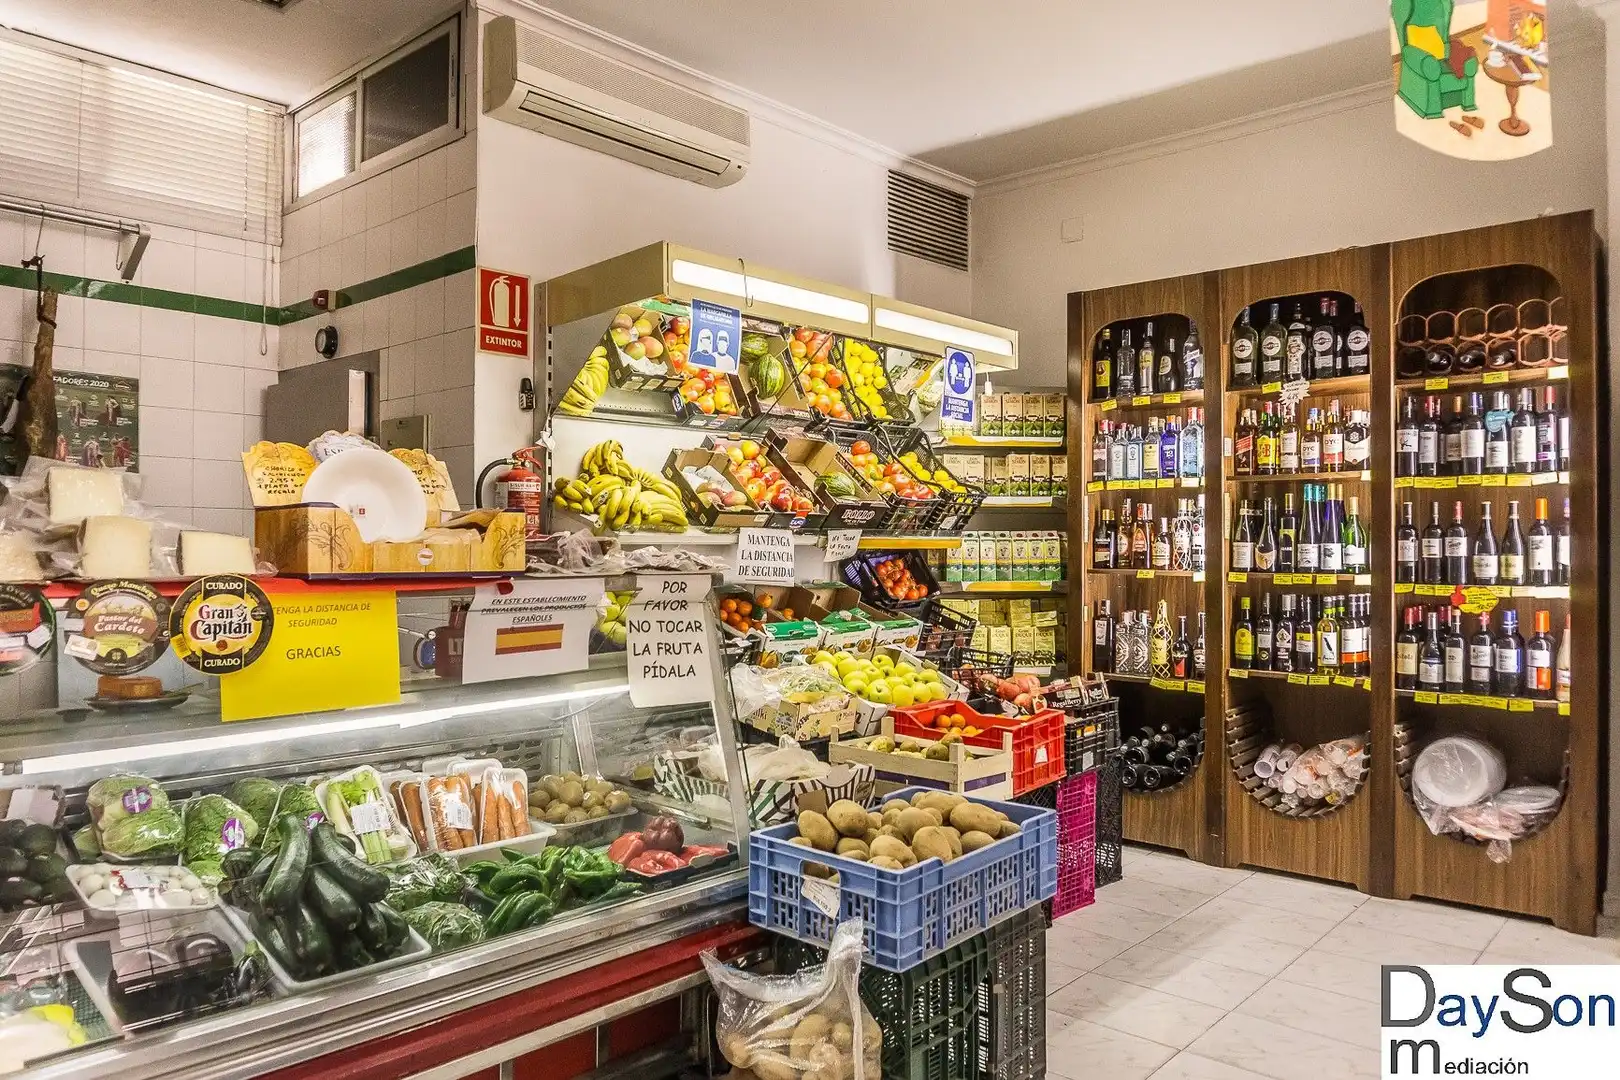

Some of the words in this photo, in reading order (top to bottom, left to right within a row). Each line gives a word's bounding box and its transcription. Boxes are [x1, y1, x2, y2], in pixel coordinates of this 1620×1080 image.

[485, 335, 522, 348] EXTINTOR
[89, 380, 110, 388] 2020
[841, 508, 876, 520] BOLLO
[747, 534, 791, 547] MANTENGA
[741, 549, 753, 560] LA
[754, 550, 793, 562] DISTANCIA
[738, 565, 750, 576] DE
[752, 566, 795, 578] SEGURIDAD
[205, 582, 243, 590] CURADO
[662, 581, 688, 594] POR
[523, 595, 587, 604] ESTABLECIMIENTO
[643, 599, 688, 611] FAVOR
[198, 604, 233, 620] Gran
[273, 606, 301, 615] ENGA
[303, 605, 313, 613] LA
[315, 603, 359, 612] DISTANCIA
[360, 602, 371, 610] DE
[481, 605, 529, 613] PREVALECEN
[544, 603, 587, 611] PRODUCTOS
[98, 615, 127, 623] Pastor
[129, 615, 143, 624] del
[288, 617, 338, 628] SEGURIDAD
[512, 614, 553, 624] ESPAÑOLES
[190, 619, 253, 641] Capitán
[629, 620, 651, 633] NO
[656, 620, 703, 633] TOCAR
[286, 645, 341, 660] GRACIAS
[633, 642, 651, 656] LA
[657, 642, 703, 656] FRUTA
[204, 658, 240, 667] CURADO
[643, 660, 696, 679] PÍDALA
